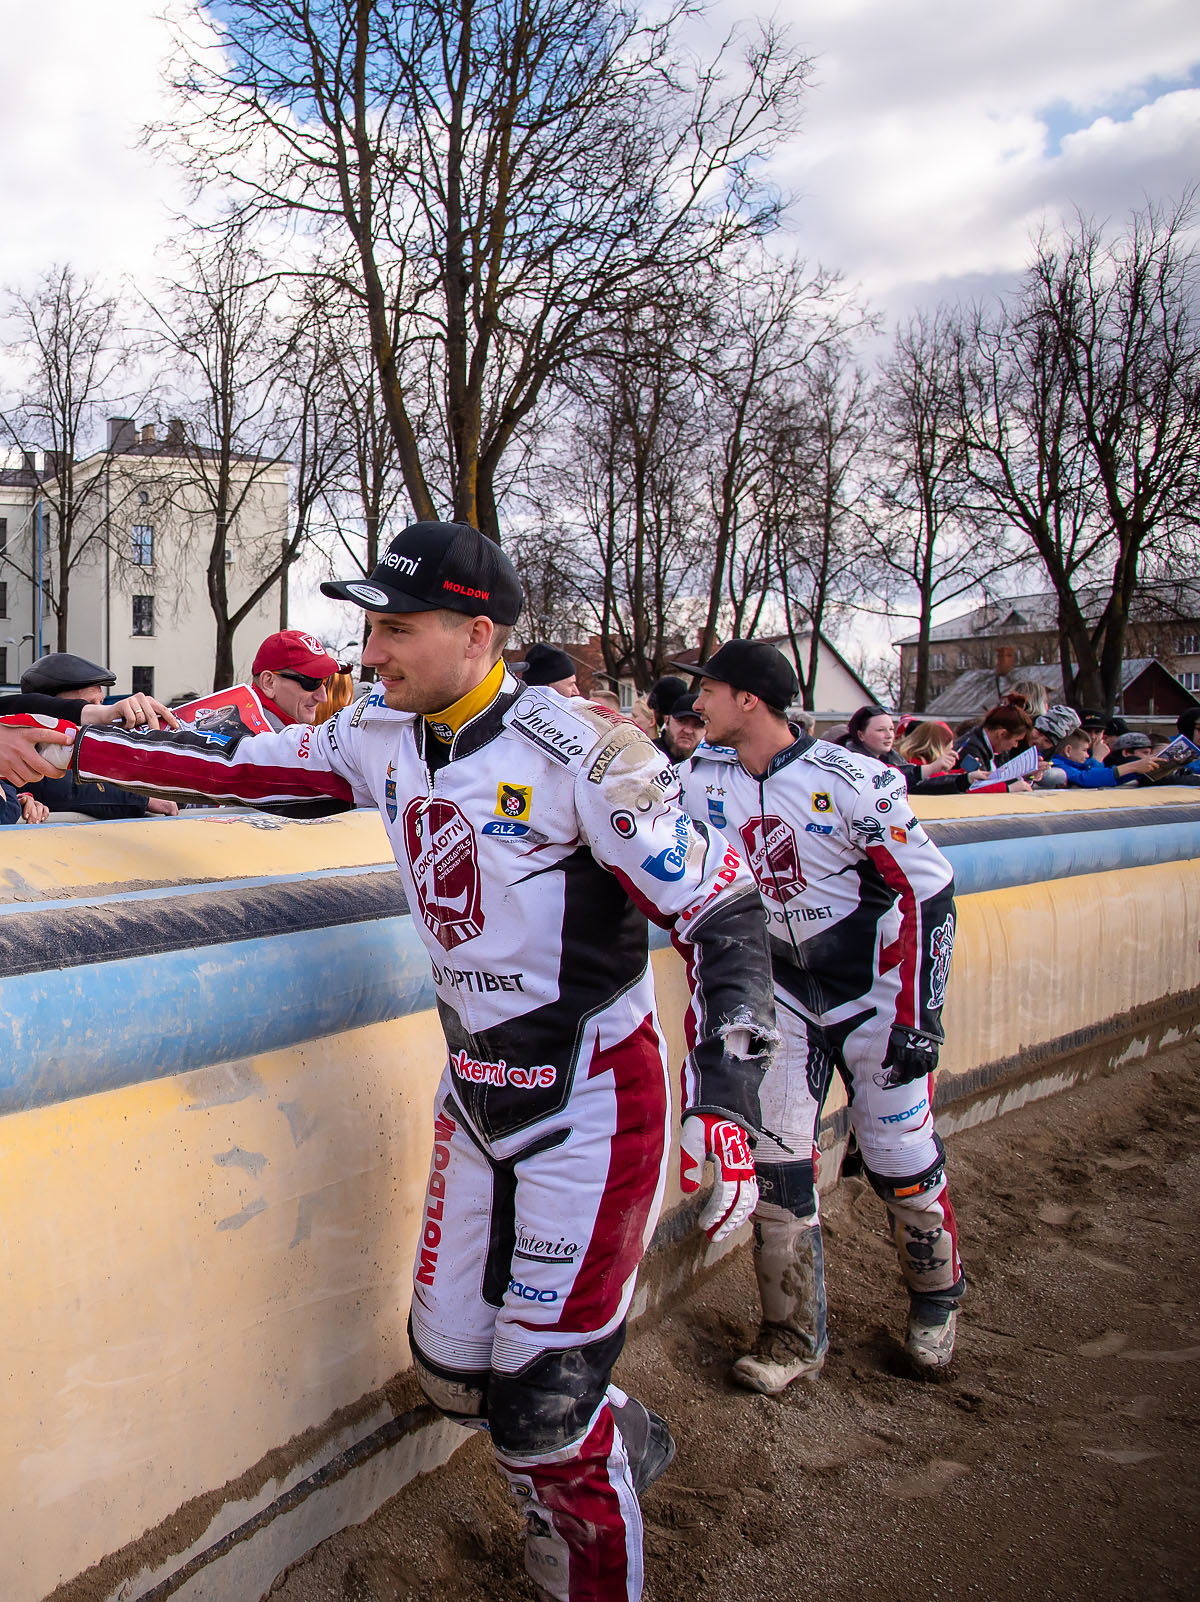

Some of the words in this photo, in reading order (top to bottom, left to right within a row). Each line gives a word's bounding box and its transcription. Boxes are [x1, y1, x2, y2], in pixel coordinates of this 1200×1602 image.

[442, 580, 490, 601] MOLDOW
[514, 694, 586, 756] Interio
[505, 808, 519, 816] PZM
[492, 823, 516, 835] 2LŻ
[415, 819, 464, 880] LOKOMOTIV
[773, 906, 833, 923] OPTIBET
[443, 966, 525, 992] OPTIBET
[878, 1099, 927, 1124] TRODO
[416, 1112, 456, 1286] MOLDOW
